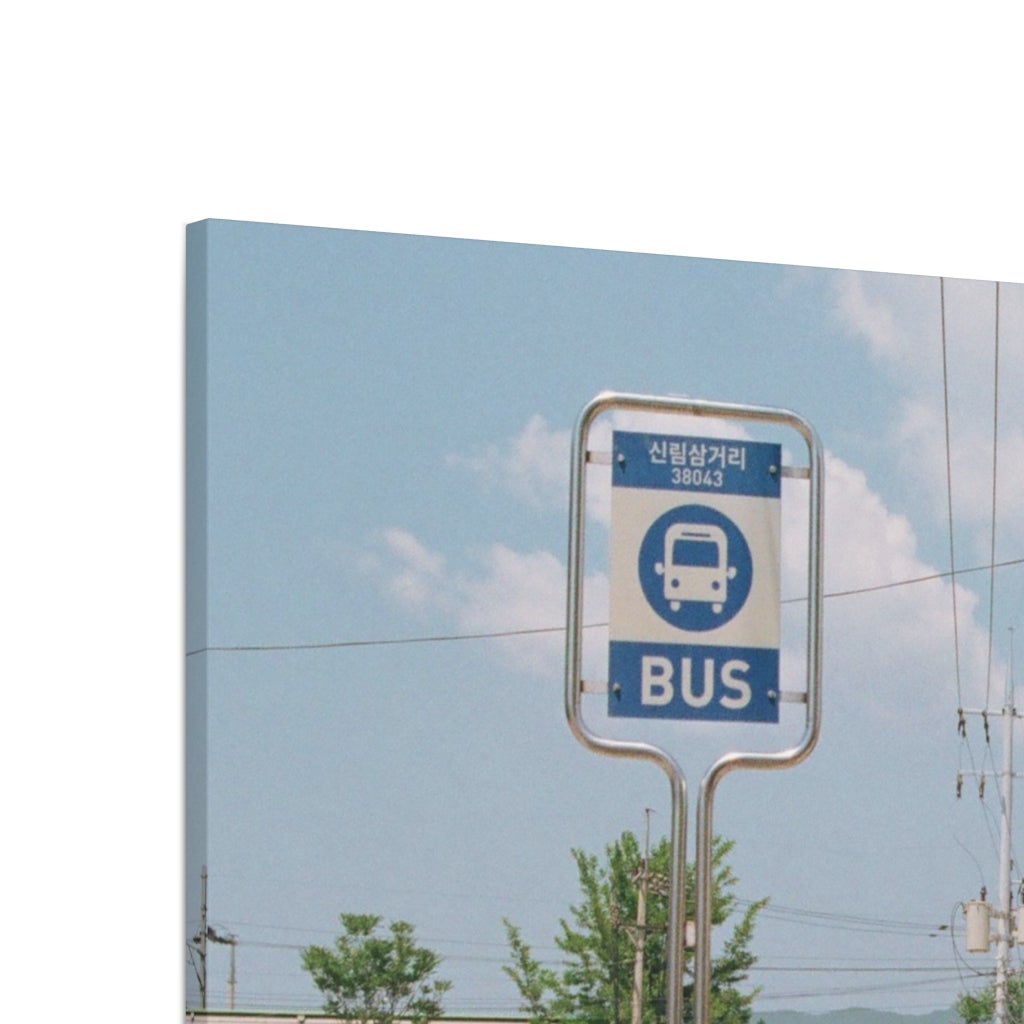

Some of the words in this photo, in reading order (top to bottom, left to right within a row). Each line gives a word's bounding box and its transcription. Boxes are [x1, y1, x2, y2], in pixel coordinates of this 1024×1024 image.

[649, 441, 746, 470] 신림삼거리
[671, 467, 723, 487] 38043
[641, 655, 752, 709] BUS
